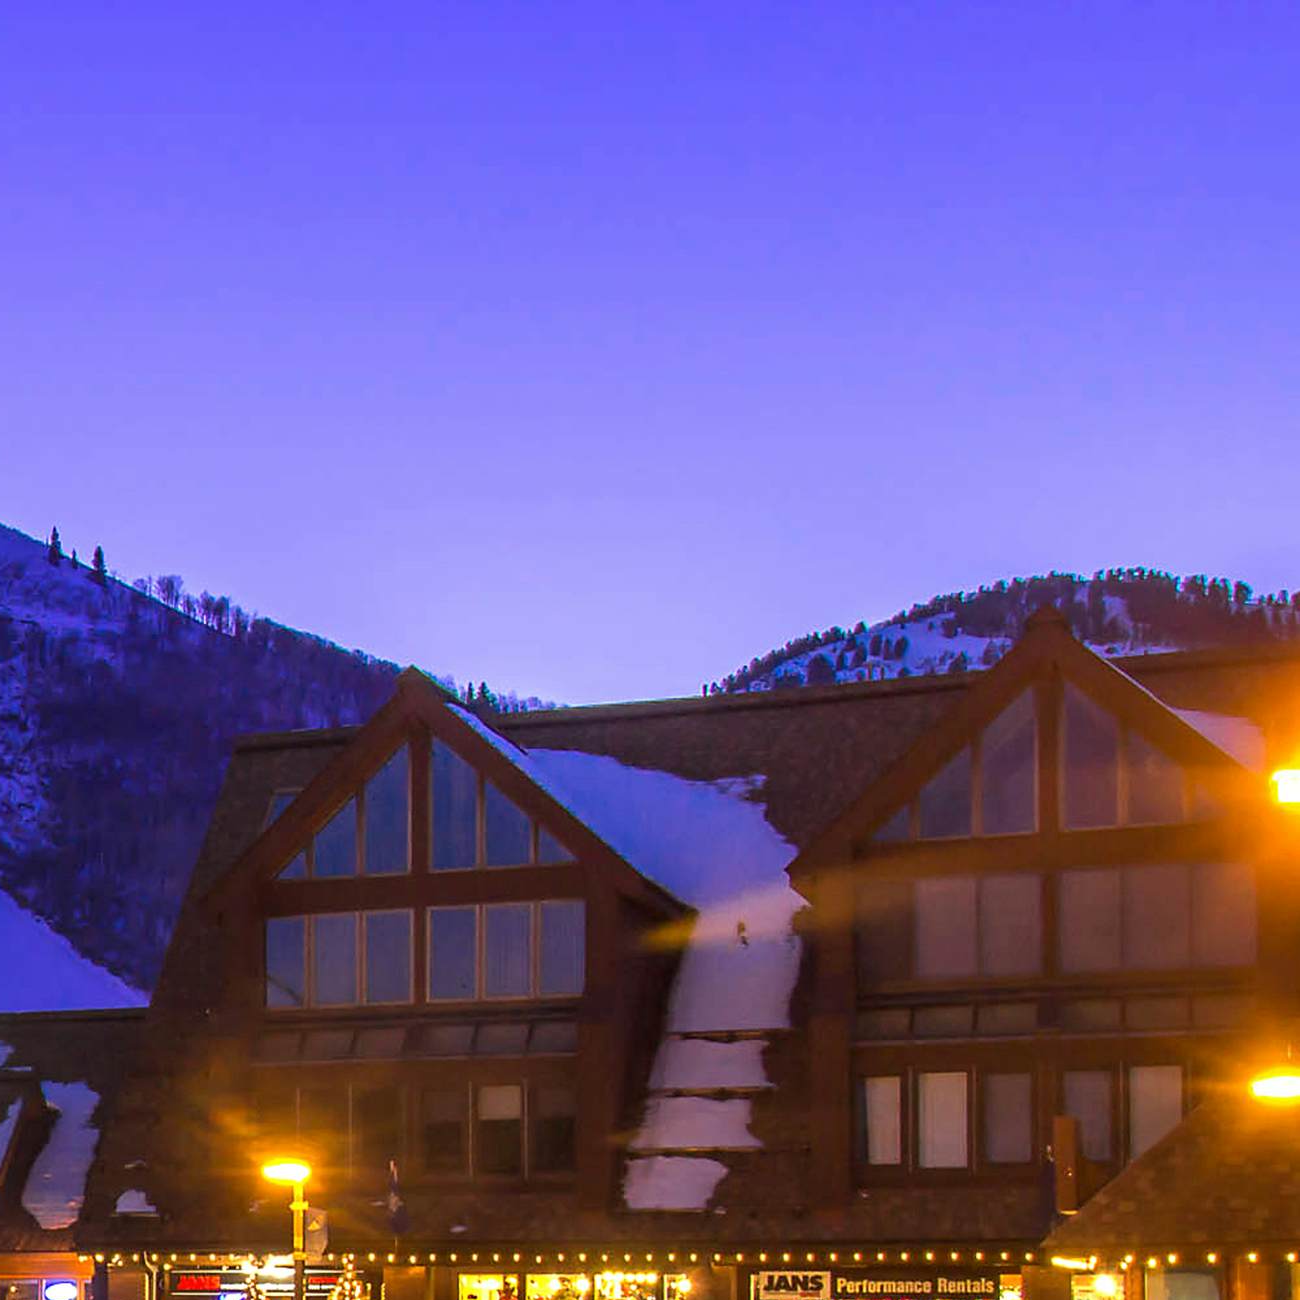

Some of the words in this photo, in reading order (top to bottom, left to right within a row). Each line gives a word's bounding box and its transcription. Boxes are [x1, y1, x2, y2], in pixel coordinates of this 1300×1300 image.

[763, 1275, 824, 1292] JANS
[836, 1278, 932, 1294] Performance
[937, 1278, 995, 1293] Rentals
